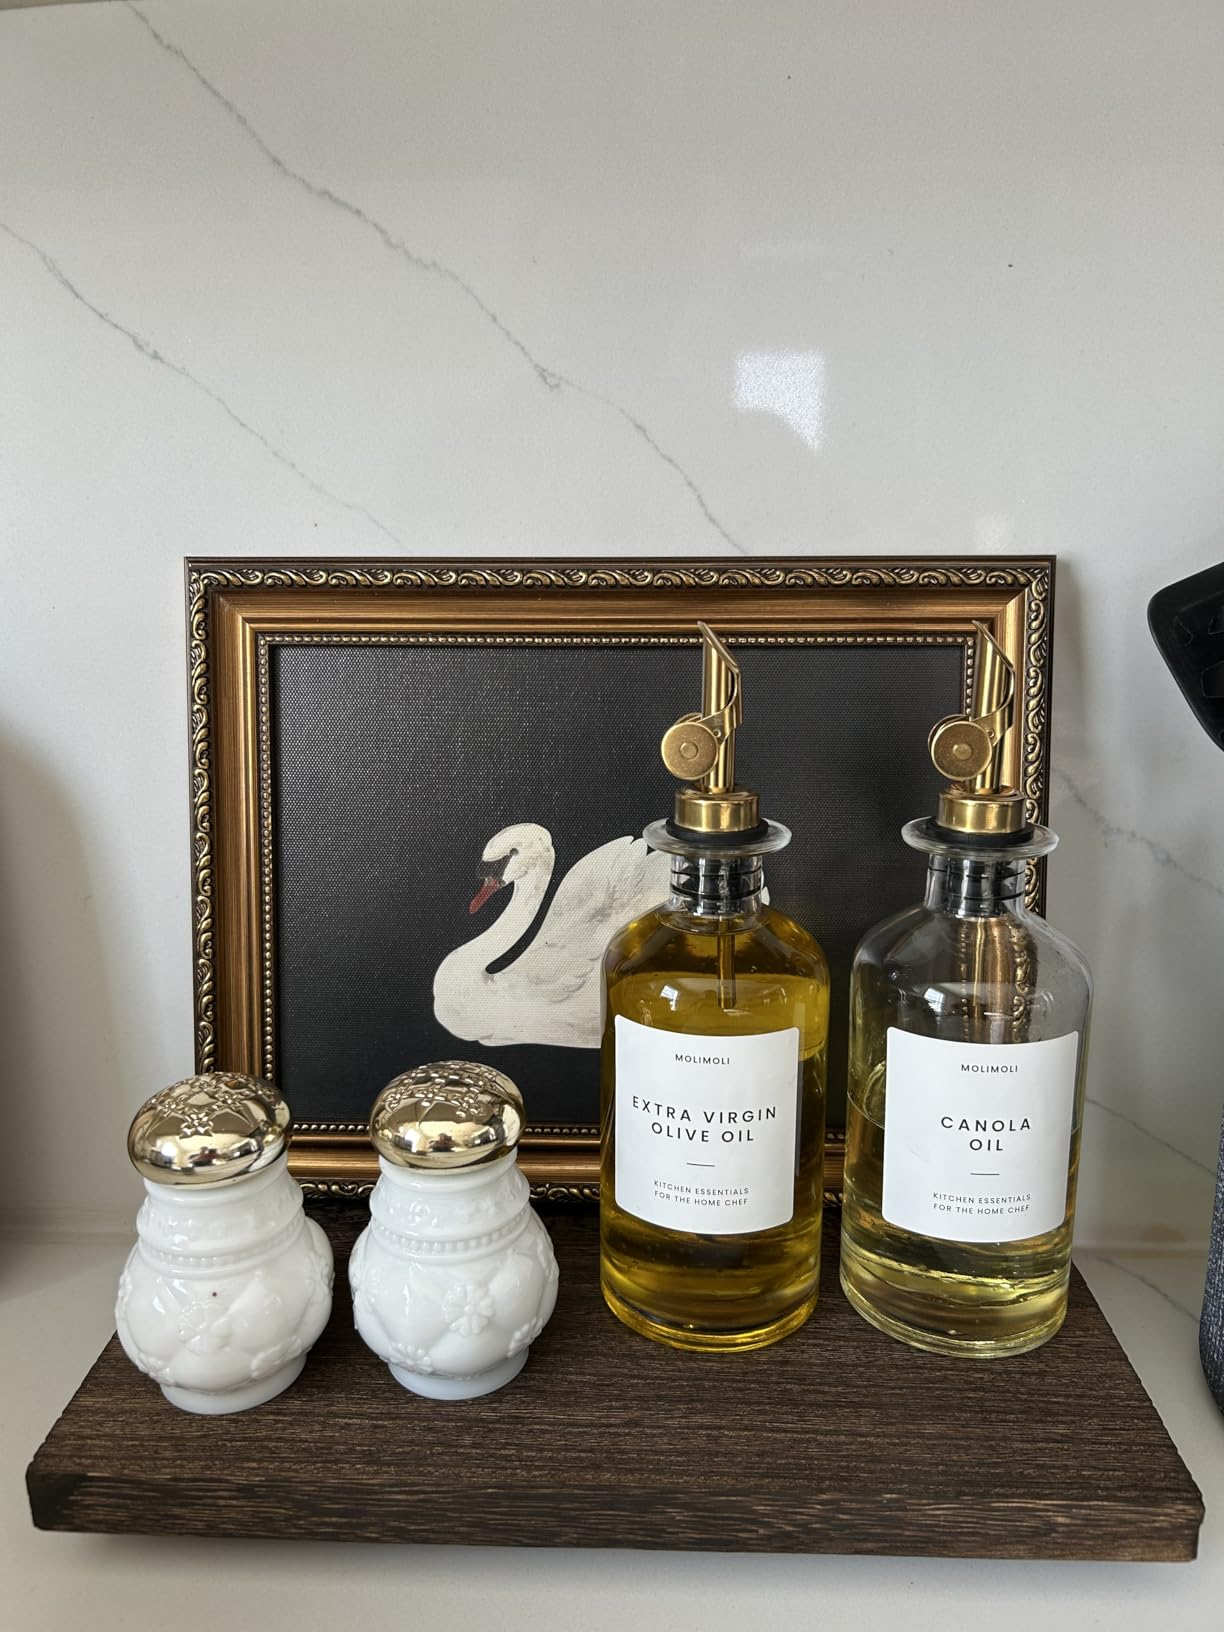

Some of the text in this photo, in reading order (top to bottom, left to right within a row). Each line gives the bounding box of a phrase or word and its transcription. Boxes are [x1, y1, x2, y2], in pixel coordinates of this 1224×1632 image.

[675, 1053, 730, 1065] MOLIMOLI
[961, 1064, 1018, 1073] MOLIMOLI
[632, 1095, 776, 1124] EXTRA VIRGIN
[940, 1116, 1031, 1132] CANOLA
[651, 1122, 754, 1143] OLIVE OIL
[969, 1138, 1003, 1151] OIL
[654, 1180, 749, 1196] KITCHEN ESSENTIALS
[654, 1190, 749, 1206] FOR THE HOME CHEF
[933, 1192, 1031, 1204] KITCHEN ESSENTIALS
[933, 1203, 952, 1212] FOR
[977, 1207, 1004, 1215] HOME
[1007, 1204, 1030, 1214] CHEF
